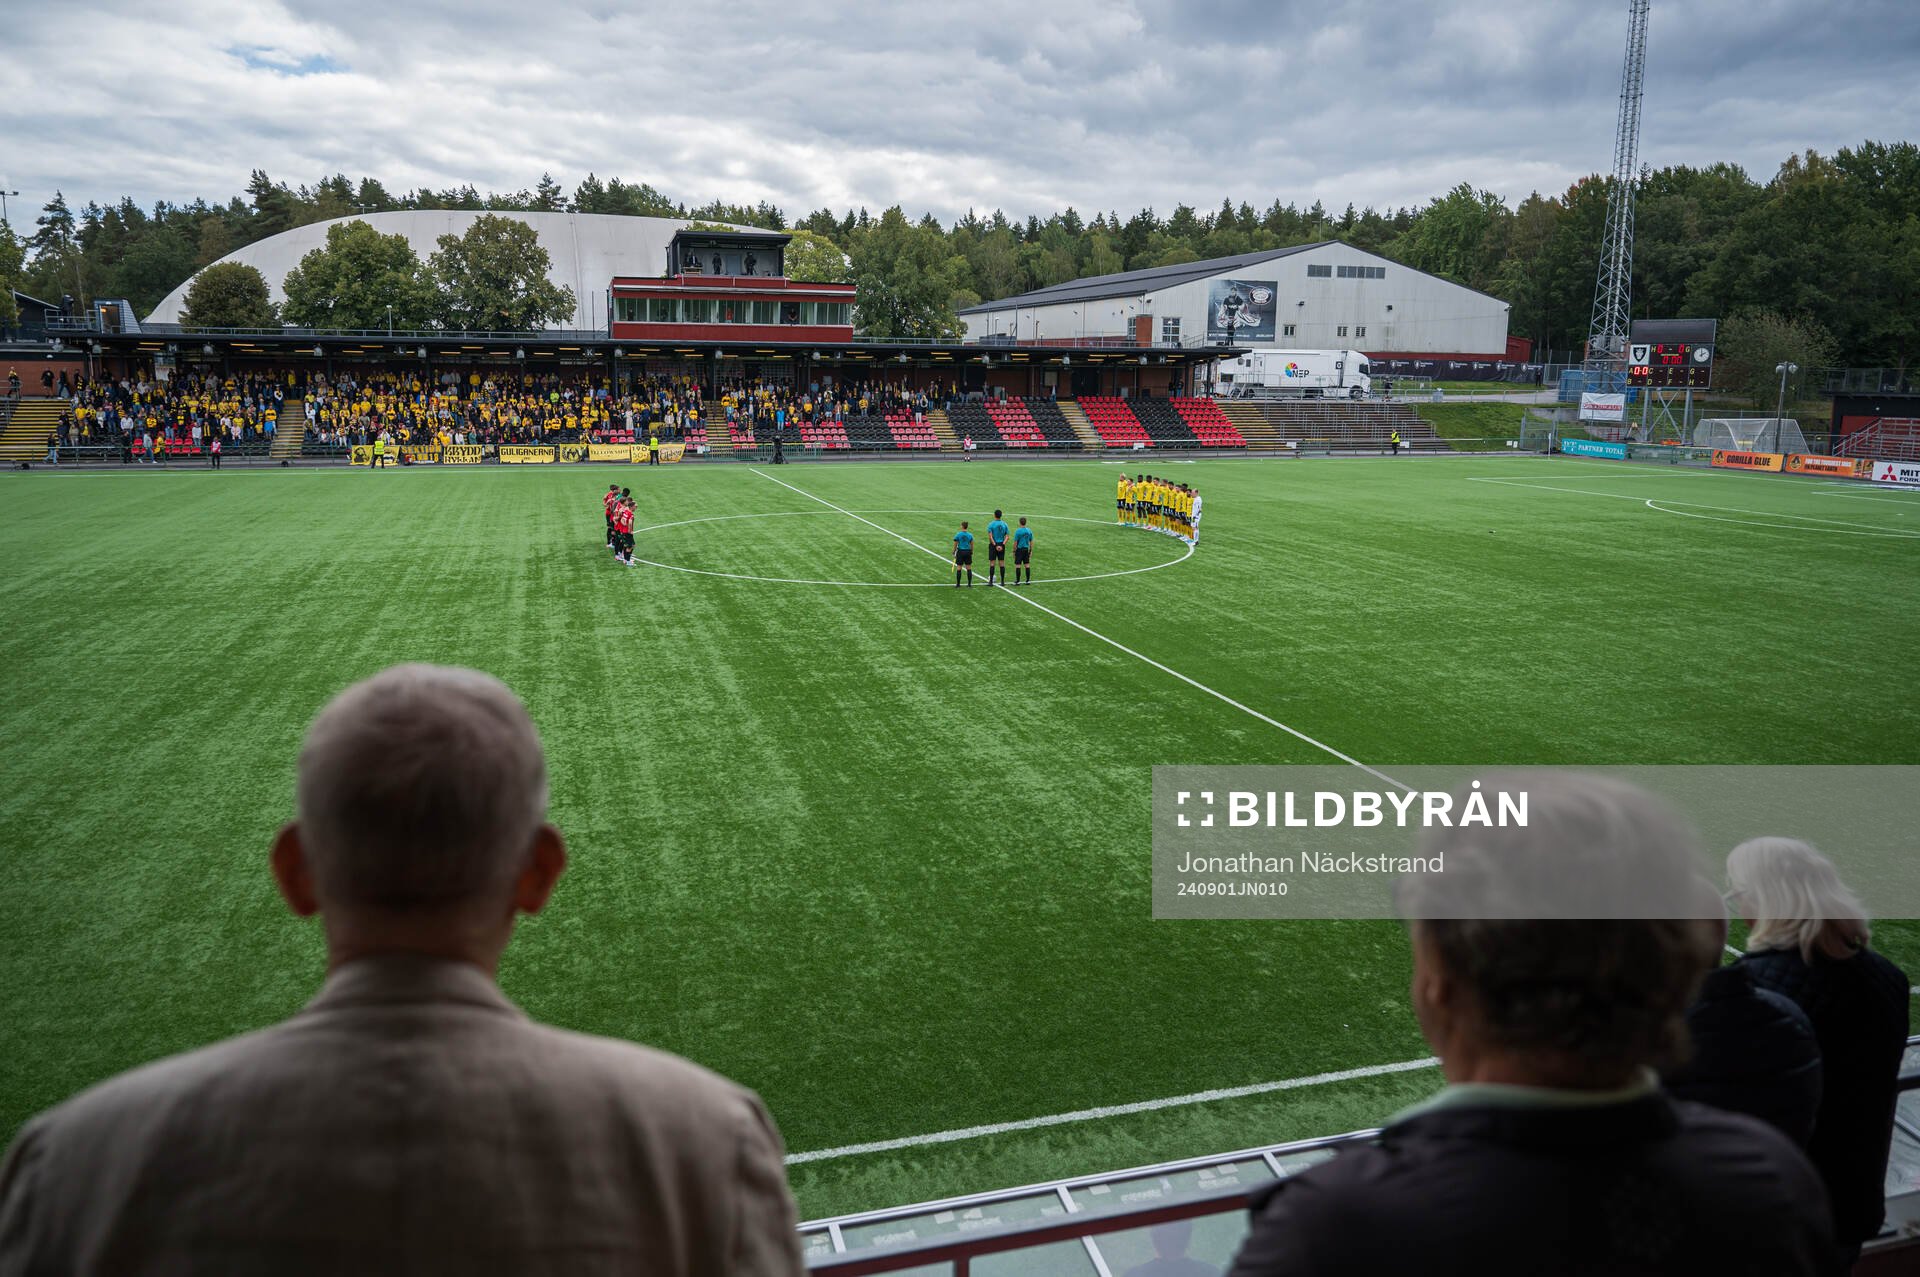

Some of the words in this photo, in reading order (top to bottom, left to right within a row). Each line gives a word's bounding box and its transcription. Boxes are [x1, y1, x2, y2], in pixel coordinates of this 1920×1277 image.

[168, 343, 177, 352] M
[1292, 369, 1310, 378] NEP
[1577, 444, 1604, 453] PARTNER
[1605, 447, 1624, 455] TOTAL
[1726, 454, 1752, 465] GORILLA
[1753, 456, 1771, 467] GLUE
